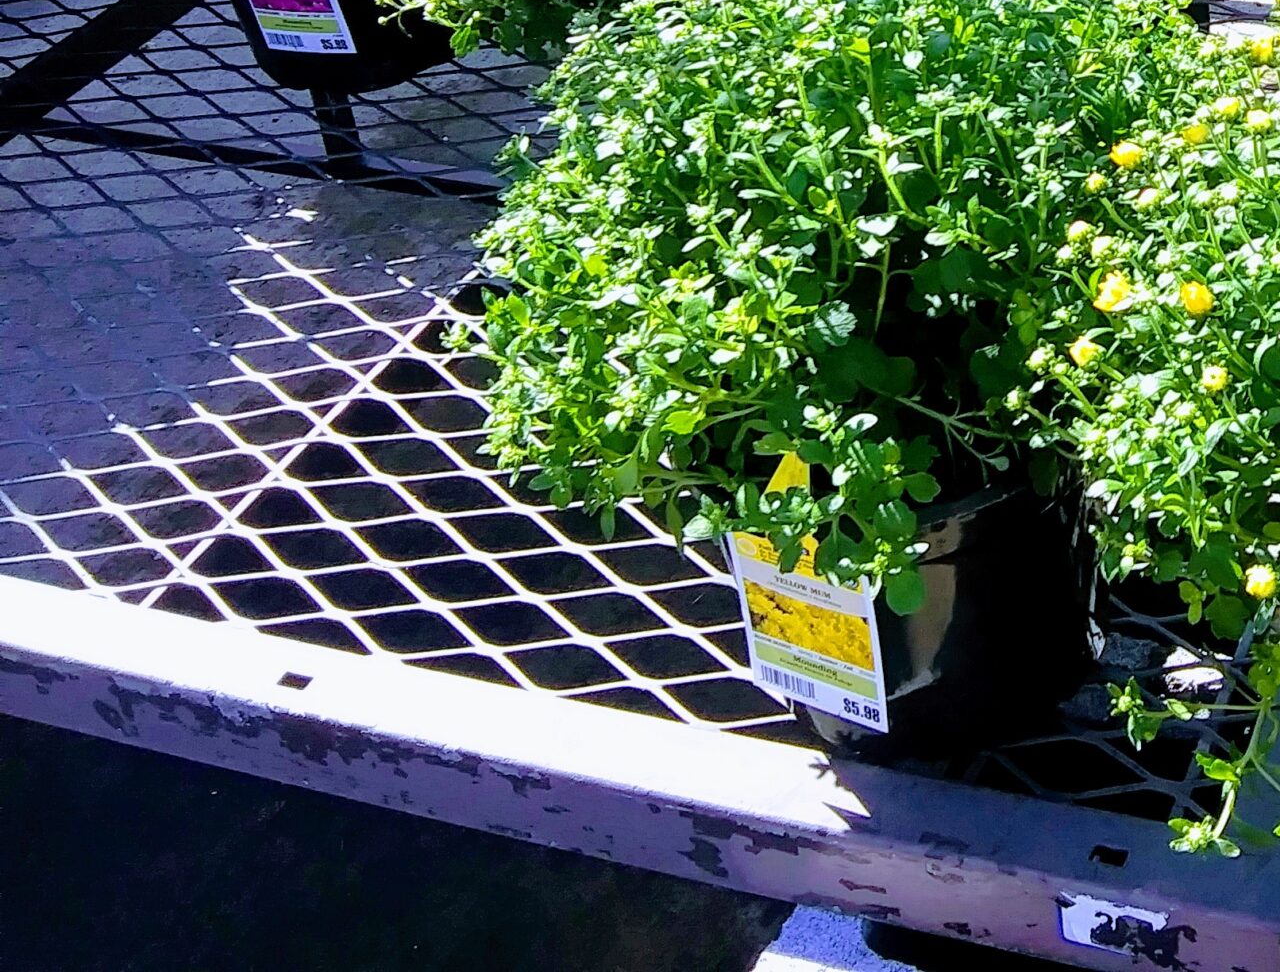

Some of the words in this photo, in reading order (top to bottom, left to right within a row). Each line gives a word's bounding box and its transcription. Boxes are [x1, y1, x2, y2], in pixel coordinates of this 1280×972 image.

[773, 574, 807, 592] YELLOW
[810, 587, 832, 600] MUM
[792, 654, 839, 677] Mounding
[842, 697, 881, 724] $5.98
